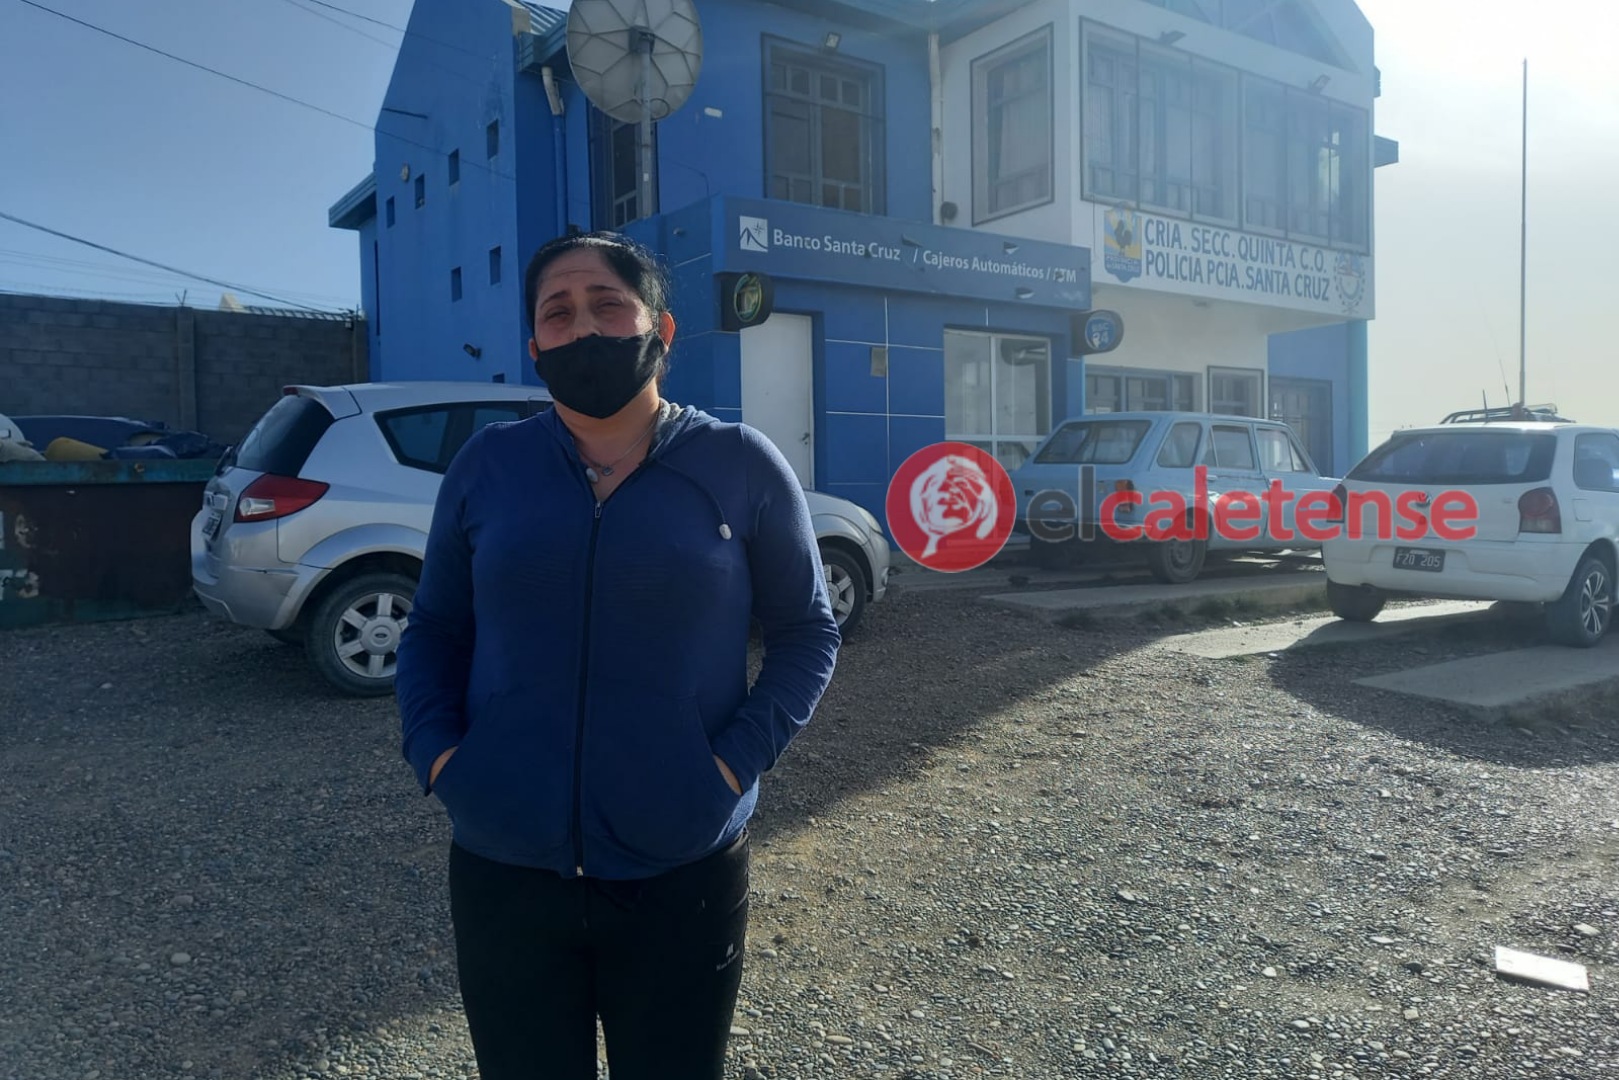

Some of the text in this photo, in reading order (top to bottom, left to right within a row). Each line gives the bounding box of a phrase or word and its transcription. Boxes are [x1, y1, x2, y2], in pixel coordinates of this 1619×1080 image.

[773, 229, 821, 250] Banco
[823, 235, 865, 256] Santa
[868, 242, 901, 261] Cruz
[922, 249, 970, 271] Cajeros
[971, 256, 1044, 280] Automáticos
[1144, 218, 1328, 274] CRIA. SECC. QUINTA C.O.
[1145, 249, 1204, 284] POLICIA
[1294, 273, 1330, 301] CRUZ
